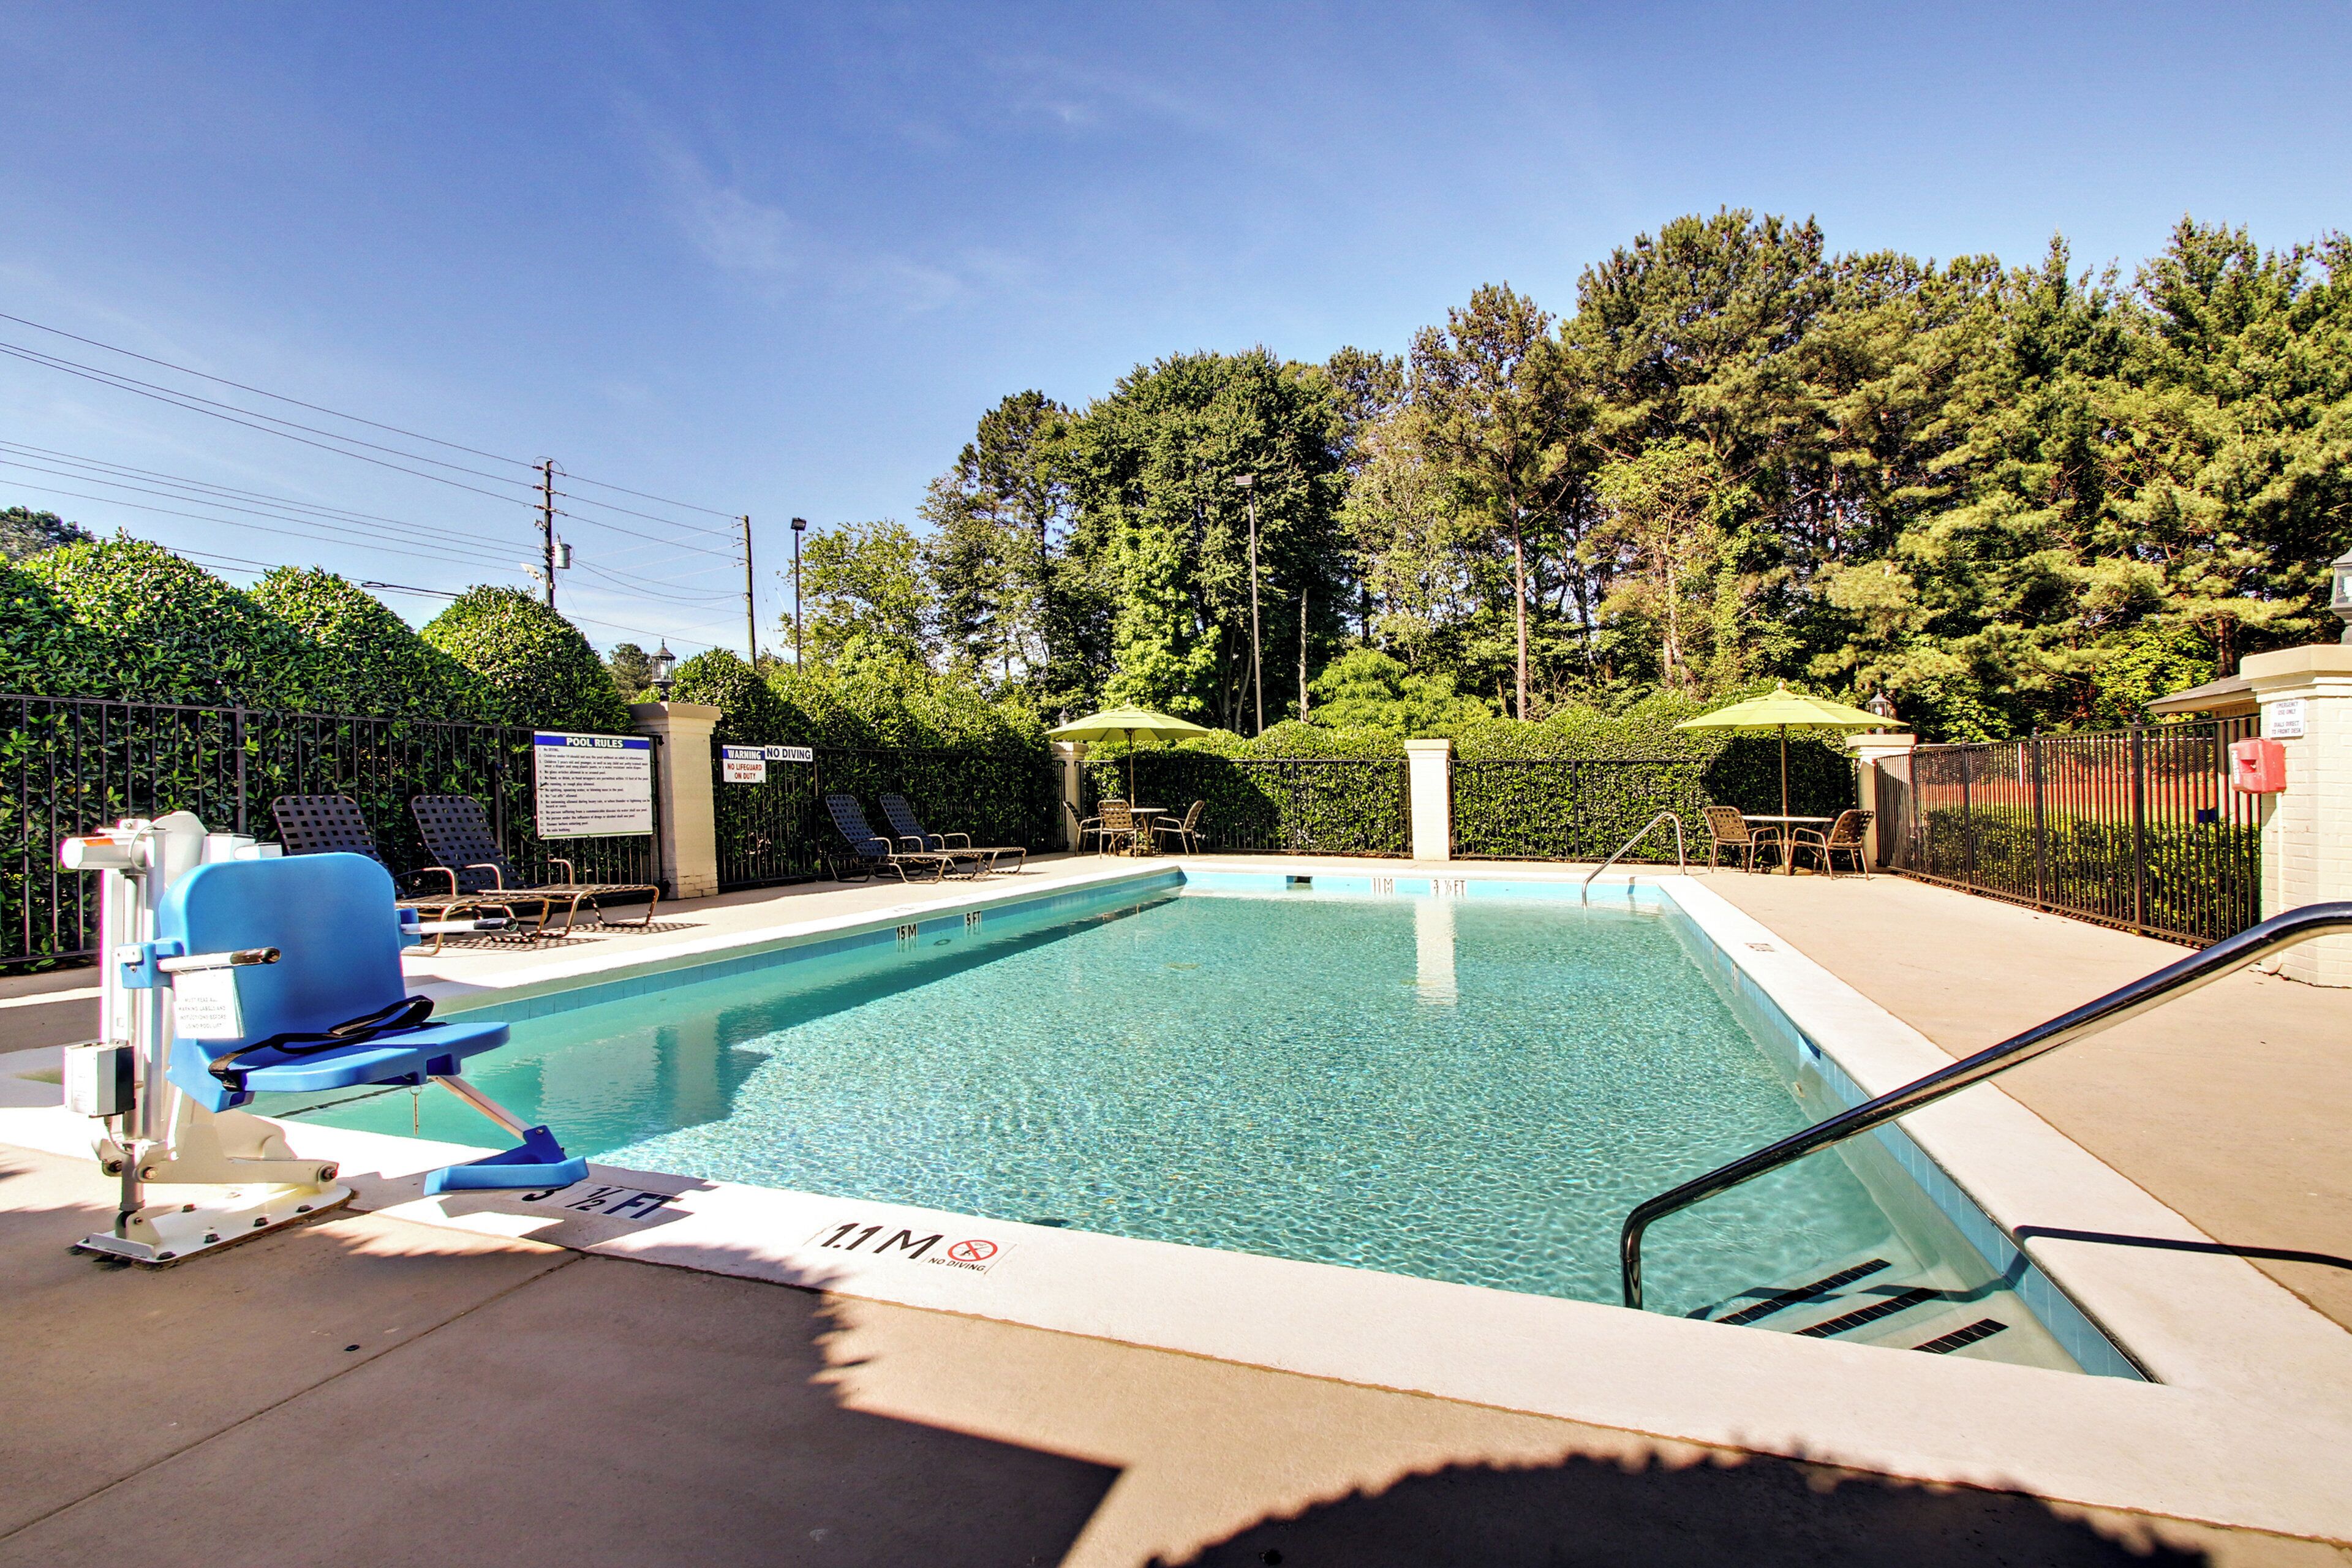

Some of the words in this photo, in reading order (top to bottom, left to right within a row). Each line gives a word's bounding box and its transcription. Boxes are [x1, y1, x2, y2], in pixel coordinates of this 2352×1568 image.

[567, 737, 592, 747] POOL
[594, 739, 624, 748] RULES
[728, 750, 761, 760] WARNING
[767, 747, 780, 758] NO
[783, 748, 811, 760] DIVING
[1384, 878, 1393, 894] M
[1433, 879, 1438, 895] 3
[1454, 880, 1465, 895] FT
[967, 913, 971, 926] 5
[973, 911, 981, 924] FT
[908, 923, 916, 938] M
[602, 1192, 676, 1219] FT
[821, 1223, 884, 1251] 1.1
[872, 1229, 944, 1259] M
[927, 1257, 946, 1266] NO
[947, 1260, 986, 1272] DIVING
